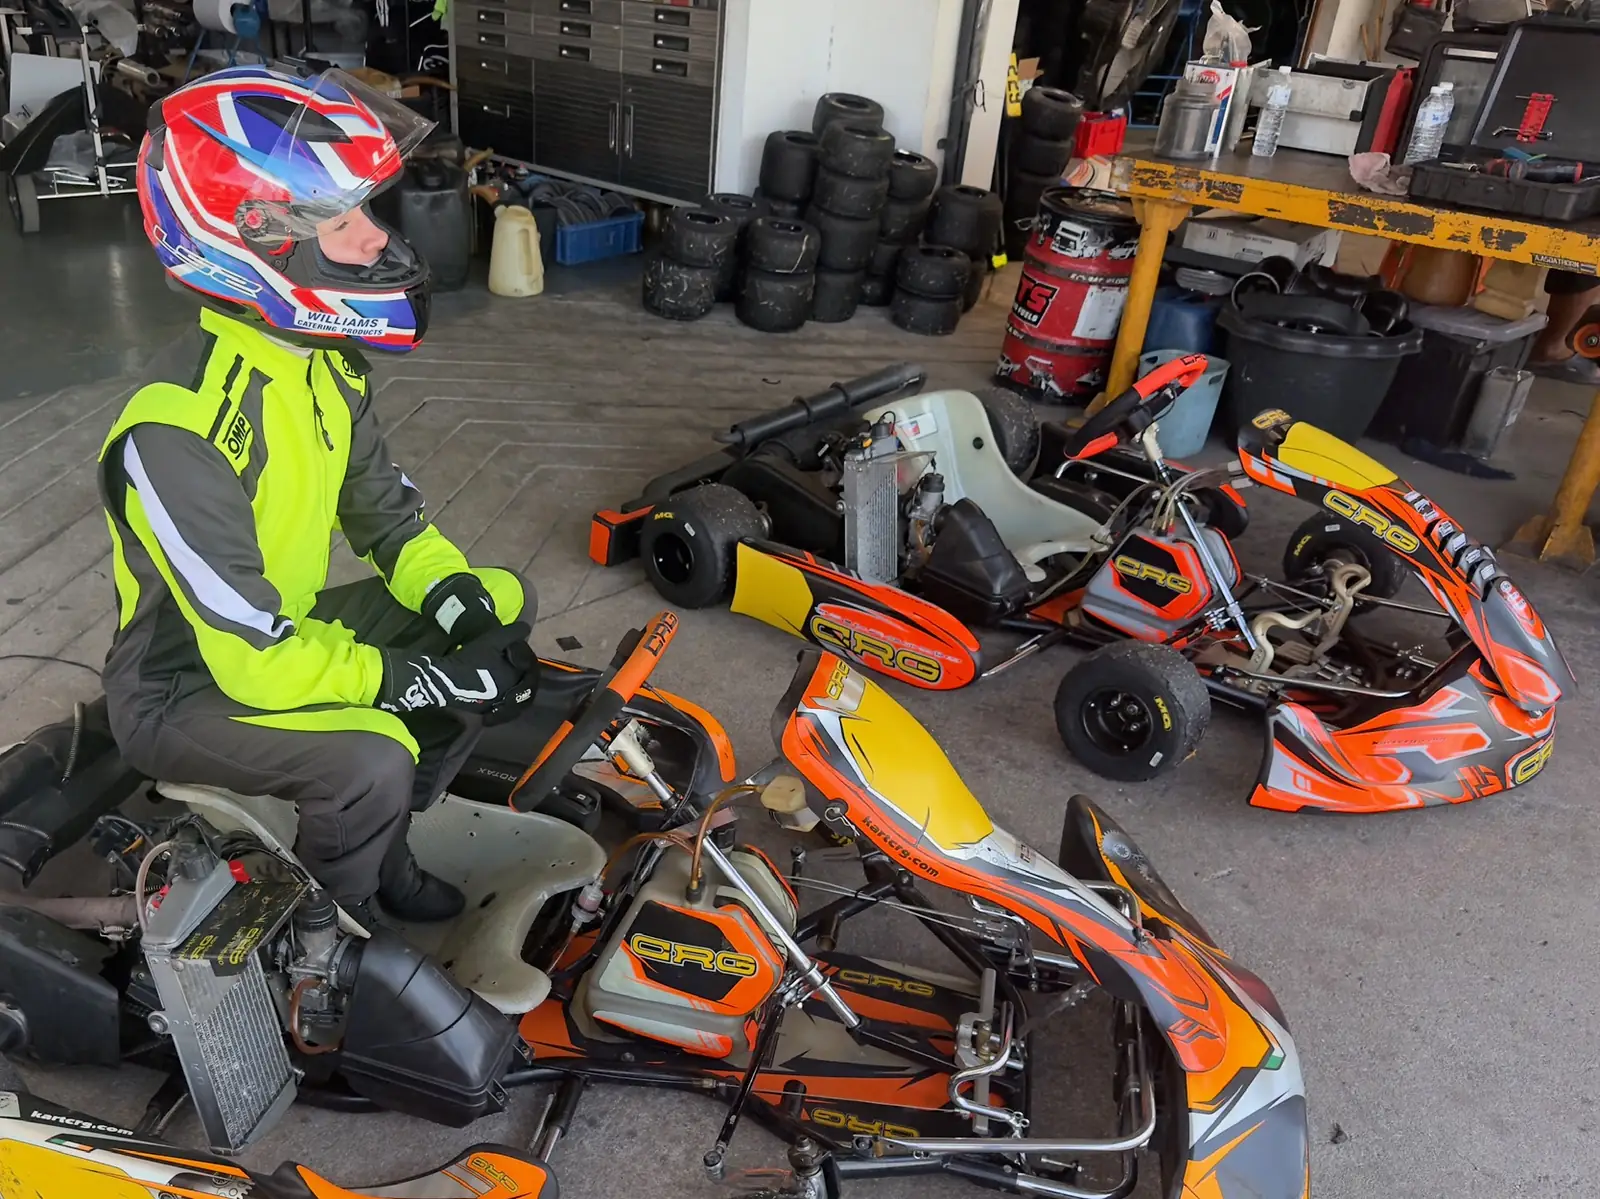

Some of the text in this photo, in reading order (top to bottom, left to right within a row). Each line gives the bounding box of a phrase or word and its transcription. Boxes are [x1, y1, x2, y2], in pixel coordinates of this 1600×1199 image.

[153, 225, 263, 299] LS2
[297, 319, 384, 336] CATERING PRODUCTS
[307, 311, 379, 329] WILLIAMS
[227, 415, 247, 455] OMP
[1322, 489, 1420, 554] CRG
[1115, 555, 1193, 595] CRG
[643, 611, 678, 657] CRG
[810, 614, 943, 684] CRG
[825, 659, 850, 701] CRG
[478, 767, 518, 782] ROTAX
[862, 815, 940, 877] kartcrg.com
[190, 935, 213, 960] RG
[229, 928, 259, 964] CRG
[630, 932, 759, 978] CRG
[839, 968, 937, 997] CRG
[30, 1110, 134, 1137] kartcrg.com
[810, 1107, 920, 1138] CRG
[470, 1156, 518, 1194] CRG
